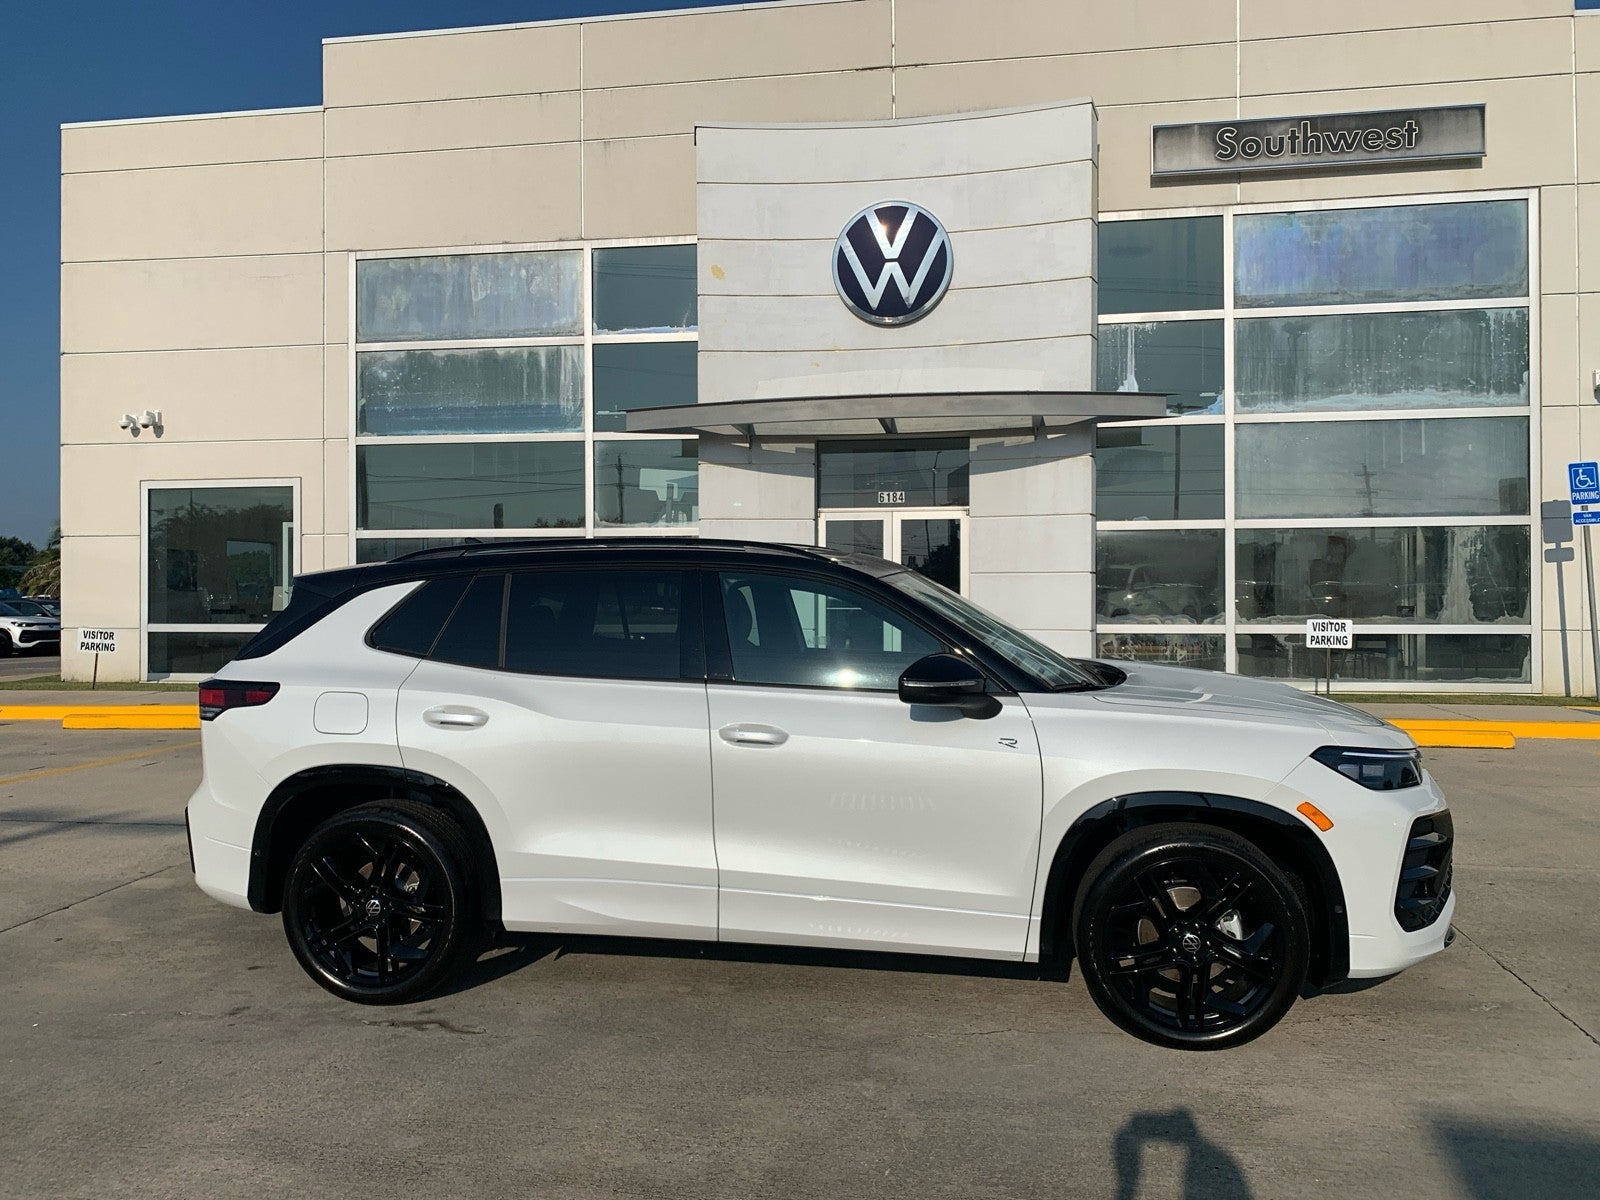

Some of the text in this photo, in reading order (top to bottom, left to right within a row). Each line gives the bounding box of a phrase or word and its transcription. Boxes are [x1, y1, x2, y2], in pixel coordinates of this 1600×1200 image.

[1215, 120, 1418, 160] Southwest
[880, 492, 904, 503] 6184
[1572, 491, 1600, 500] PARKING
[1312, 622, 1346, 632] VISITOR
[83, 630, 114, 640] VISITOR
[1310, 635, 1348, 646] PARKING
[80, 641, 115, 652] PARKING
